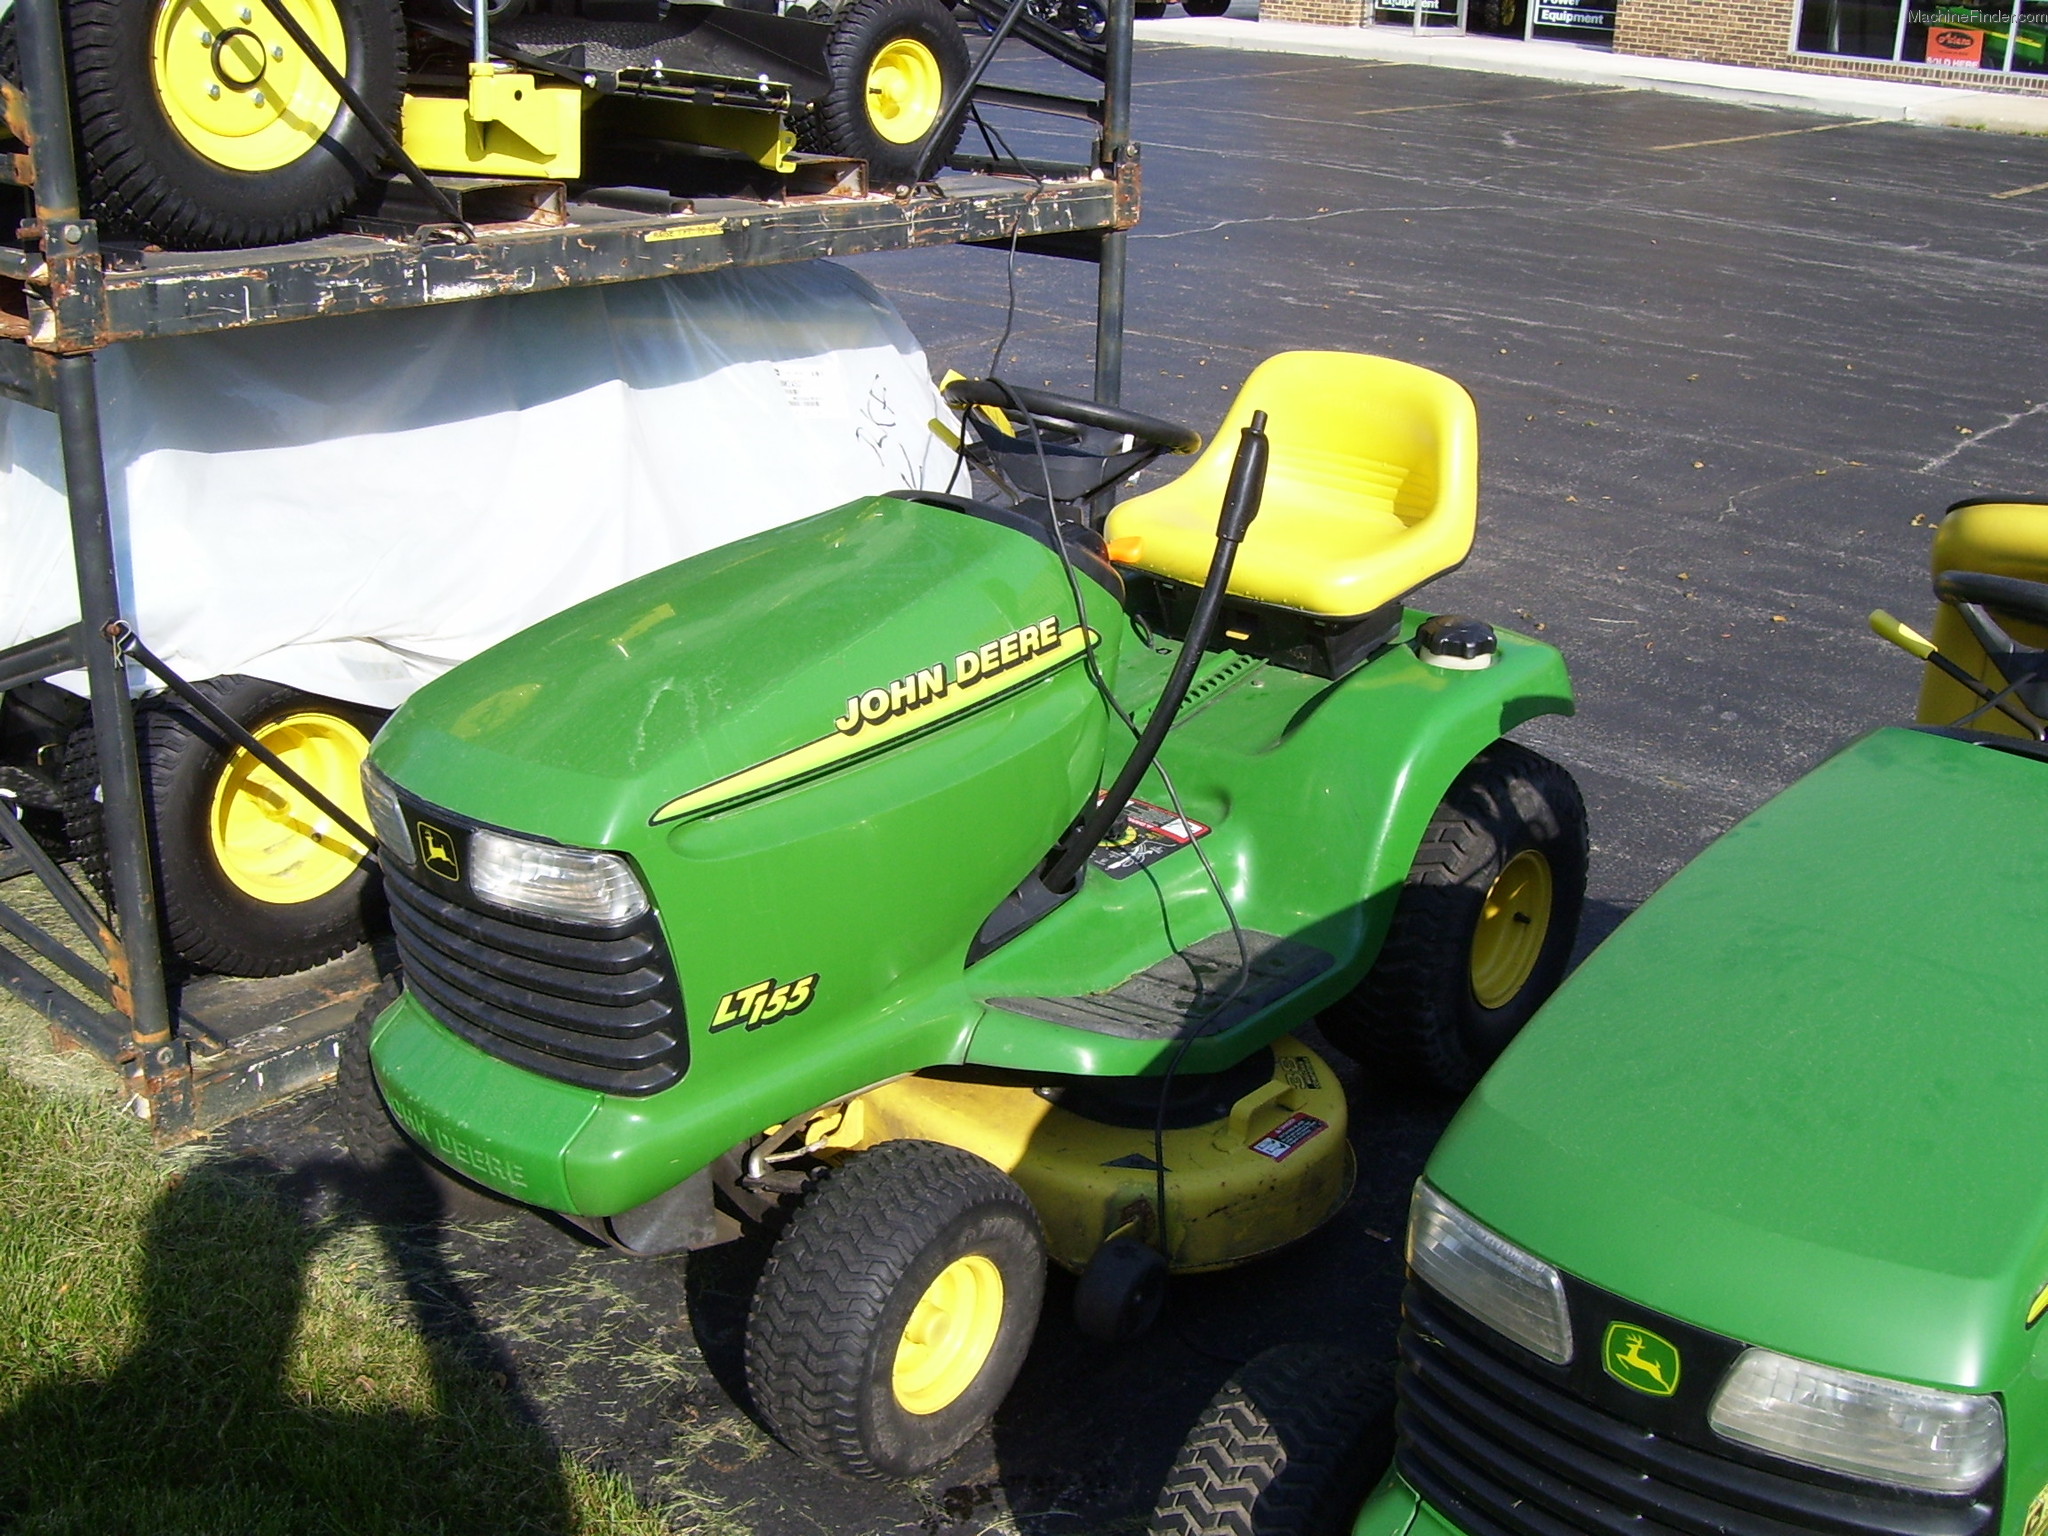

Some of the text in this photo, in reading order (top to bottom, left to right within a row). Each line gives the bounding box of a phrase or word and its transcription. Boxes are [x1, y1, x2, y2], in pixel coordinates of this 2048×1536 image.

[1541, 9, 1604, 24] Equipment
[1926, 56, 1951, 66] SOLD
[834, 615, 1061, 736] JOHN DEERE
[708, 973, 821, 1034] LT155
[435, 1127, 528, 1188] DEERE
